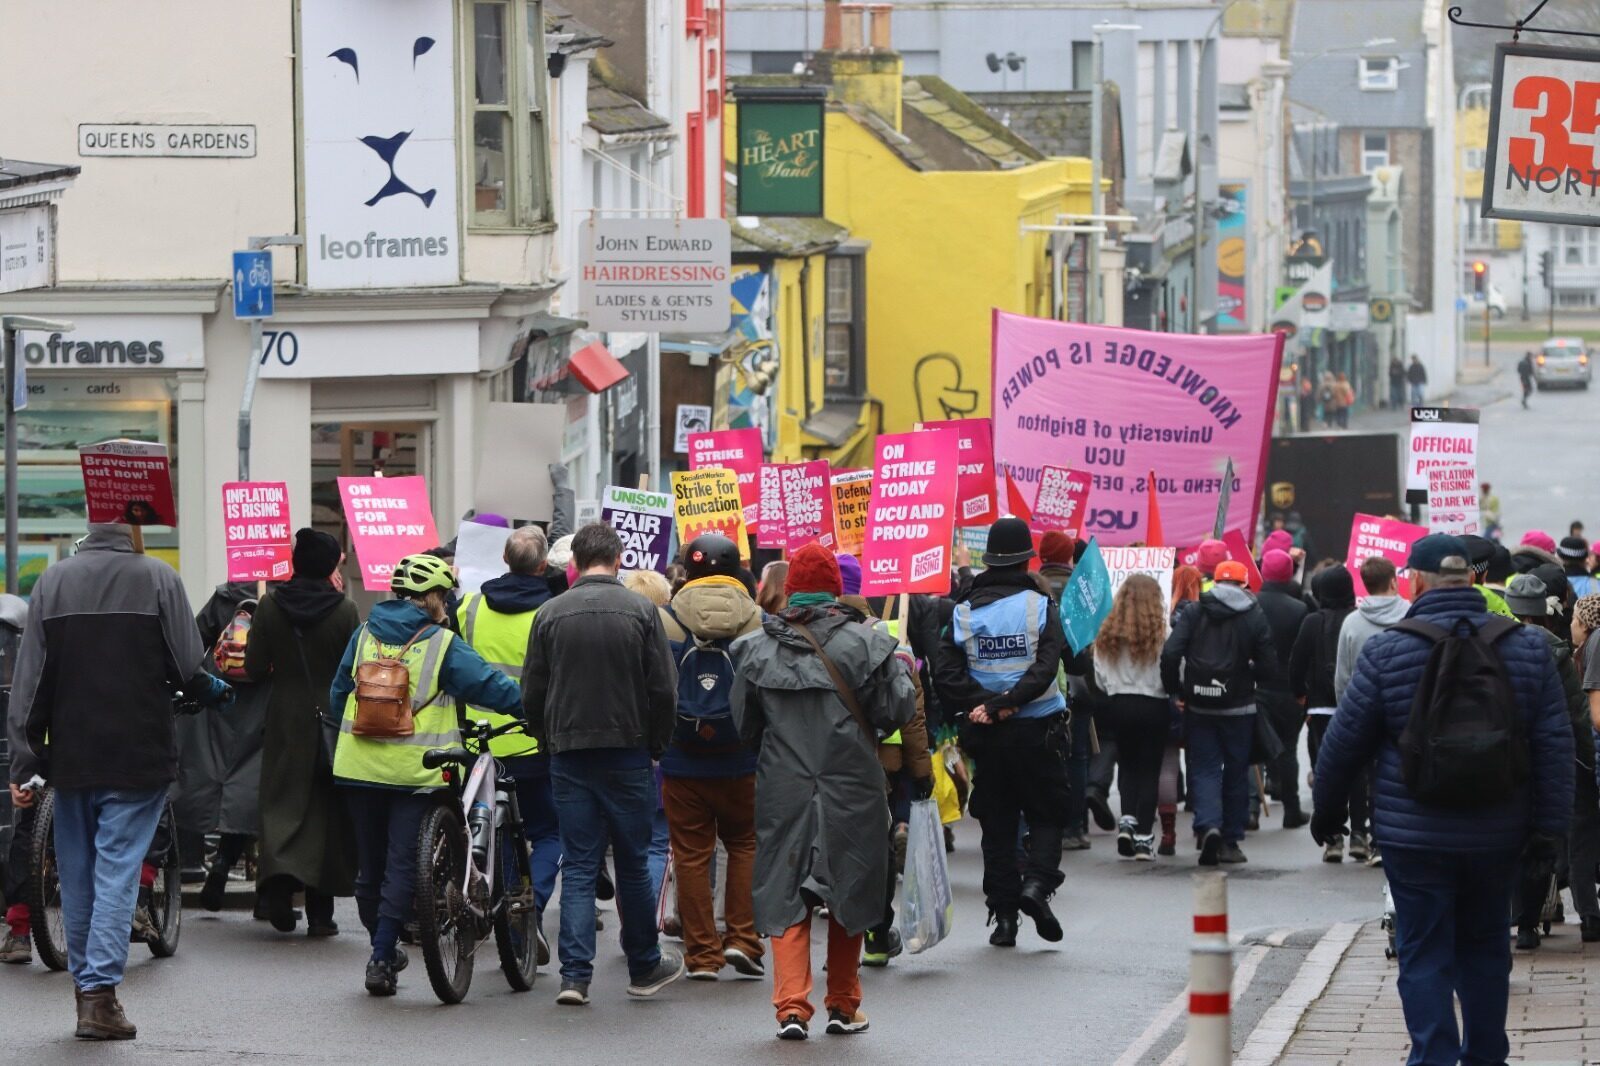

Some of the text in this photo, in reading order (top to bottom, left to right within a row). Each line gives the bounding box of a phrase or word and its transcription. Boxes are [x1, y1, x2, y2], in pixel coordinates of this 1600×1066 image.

[1508, 75, 1600, 187] 35
[85, 132, 250, 150] QUEENS GARDENS
[743, 129, 819, 166] HEART
[763, 160, 818, 178] Hand
[320, 231, 448, 260] leoframes
[596, 235, 713, 252] JOHN EDWARD
[583, 266, 726, 281] HAIRDRESSING
[596, 295, 713, 307] LADIES & GENTS
[621, 308, 687, 321] STYLISTS
[259, 331, 299, 366] 70
[86, 381, 120, 395] cards
[1413, 409, 1439, 420] UCU
[694, 438, 714, 450] ON
[1412, 436, 1474, 454] OFFICIAL
[695, 449, 744, 462] STRIKE
[882, 443, 904, 461] ON
[83, 455, 165, 470] Braverman
[881, 460, 936, 480] STRIKE
[958, 463, 984, 475] PAY
[86, 468, 149, 480] out now!
[760, 466, 779, 478] PA
[782, 467, 807, 481] PAY
[1044, 467, 1071, 480] PAY
[1430, 468, 1475, 481] INFLATION
[88, 478, 156, 493] Refugees
[347, 484, 372, 496] ON
[675, 479, 736, 500] Strike for
[782, 476, 824, 492] DOWN
[836, 482, 872, 500] Defend
[879, 480, 929, 499] TODAY
[1043, 476, 1084, 493] DOWN
[1430, 480, 1471, 492] IS RISING
[89, 489, 153, 502] welcome
[225, 487, 284, 503] INFLATION
[611, 489, 668, 509] UNISON
[785, 489, 813, 504] 25%
[1040, 486, 1069, 501] 25%
[91, 499, 125, 511] here
[351, 497, 408, 509] STRIKE
[678, 496, 739, 517] education
[786, 499, 824, 516] SINCE
[838, 501, 855, 516] the
[1038, 496, 1078, 511] SINCE
[1431, 495, 1476, 508] SO ARE WE
[227, 503, 280, 519] IS RISING
[354, 511, 388, 523] FOR
[875, 505, 908, 523] UCU
[909, 503, 945, 520] AND
[1036, 502, 1073, 518] 2009
[610, 510, 661, 535] FAIR
[787, 511, 822, 527] 2009
[840, 518, 851, 530] to
[228, 523, 287, 541] SO ARE WE
[358, 524, 425, 536] FAIR PAY
[872, 524, 929, 541] PROUD
[1359, 522, 1380, 534] ON
[616, 529, 656, 552] PAY
[1357, 533, 1407, 553] STRIKE
[620, 549, 660, 571] OW
[915, 549, 941, 564] UCU
[870, 558, 899, 573] UCU
[914, 557, 940, 577] RISING
[980, 636, 1026, 651] POLICE
